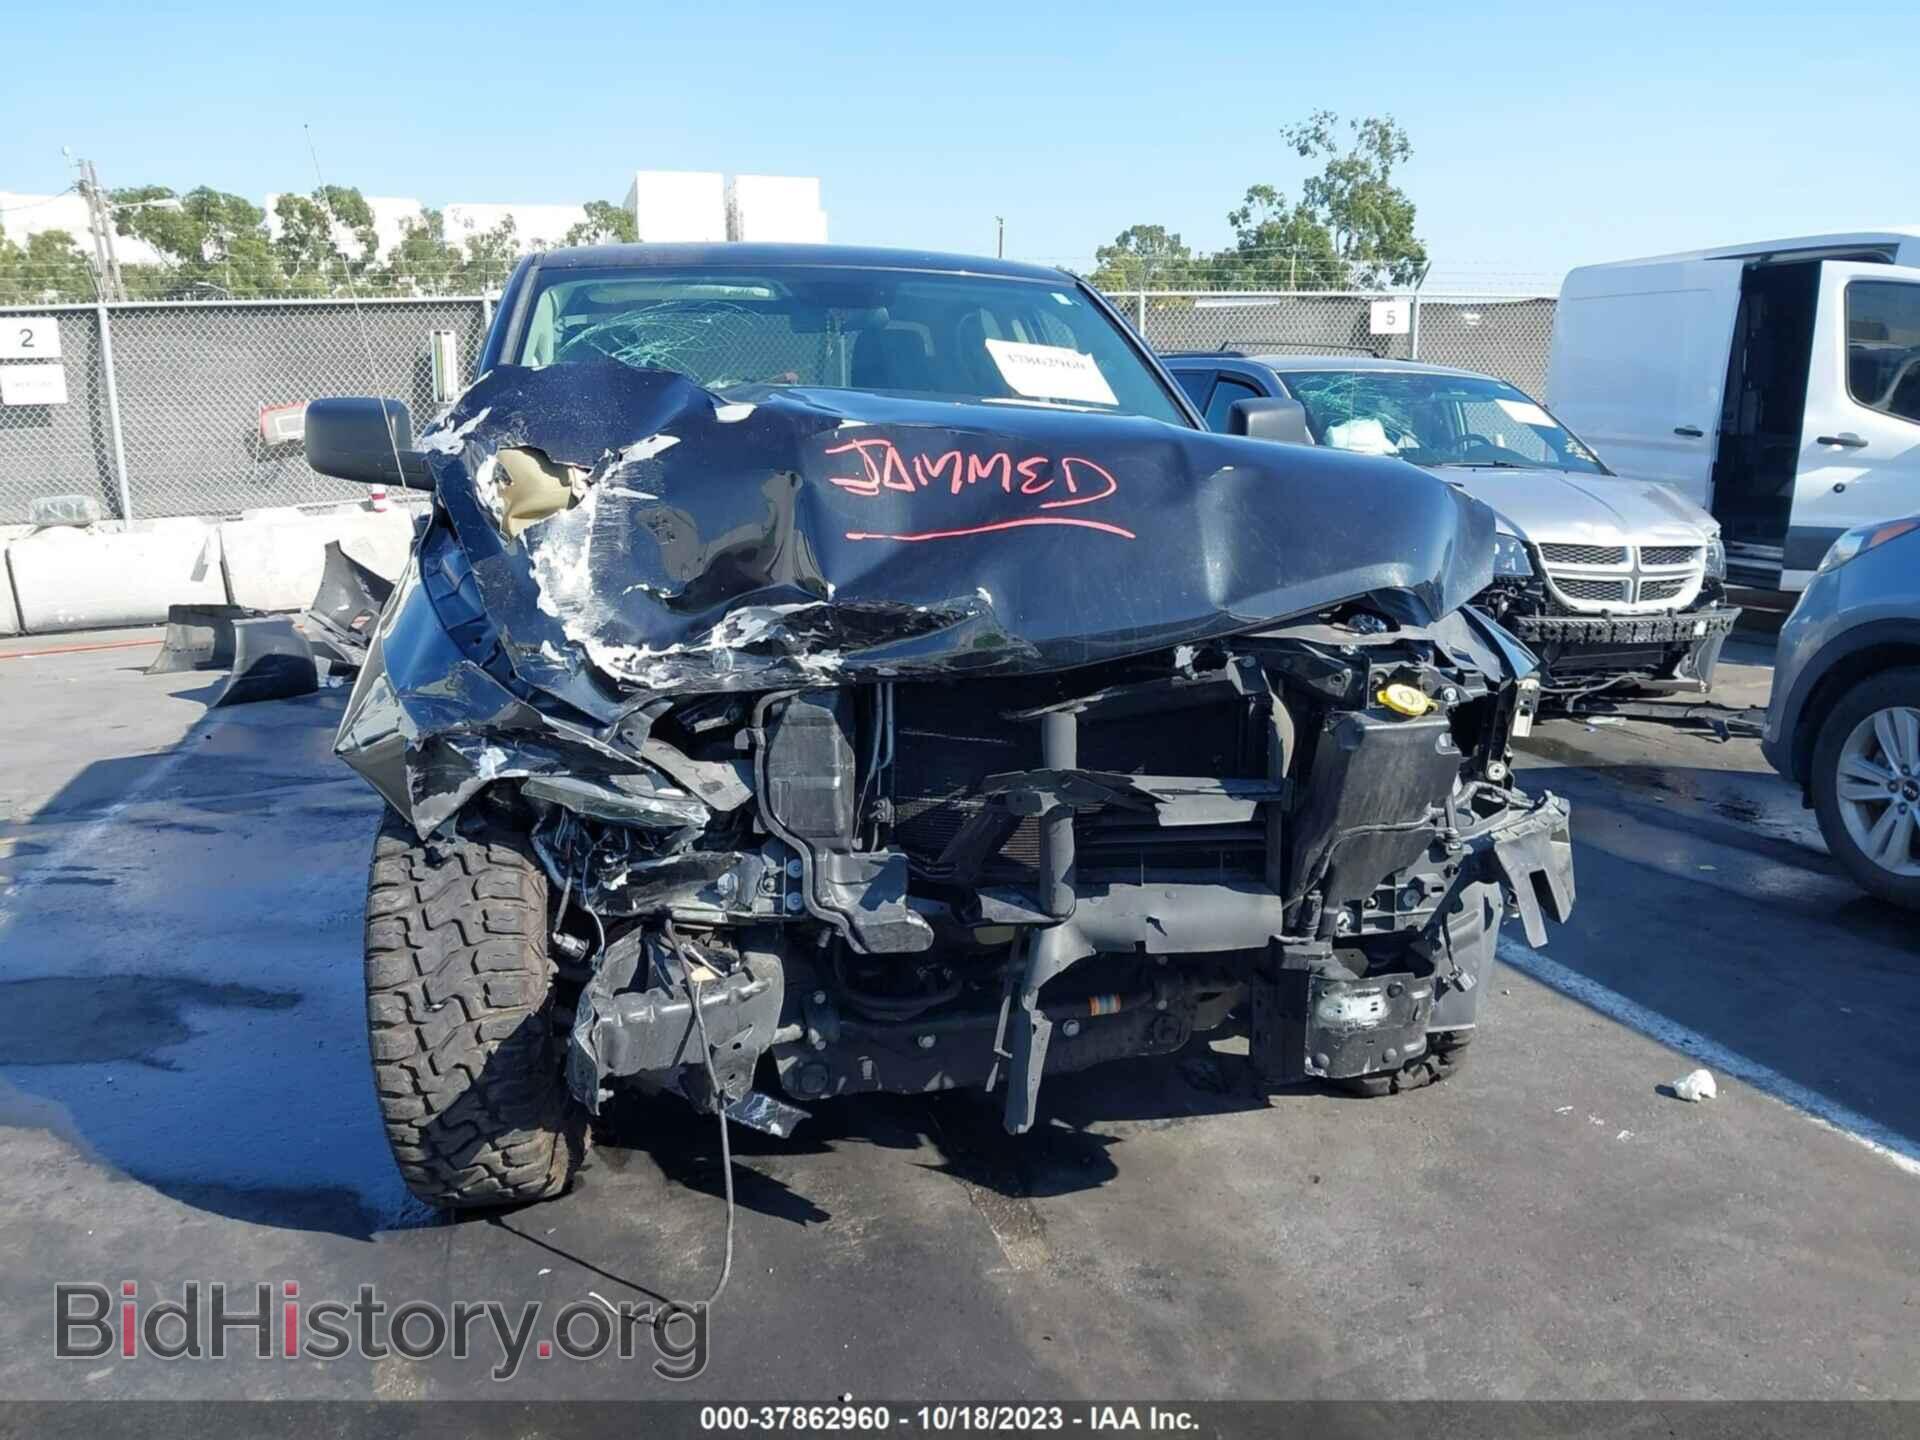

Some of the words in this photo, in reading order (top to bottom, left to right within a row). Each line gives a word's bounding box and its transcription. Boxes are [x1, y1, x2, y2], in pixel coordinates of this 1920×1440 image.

[1386, 310, 1396, 325] 5
[20, 328, 35, 347] 2
[825, 439, 1117, 508] JAMMED
